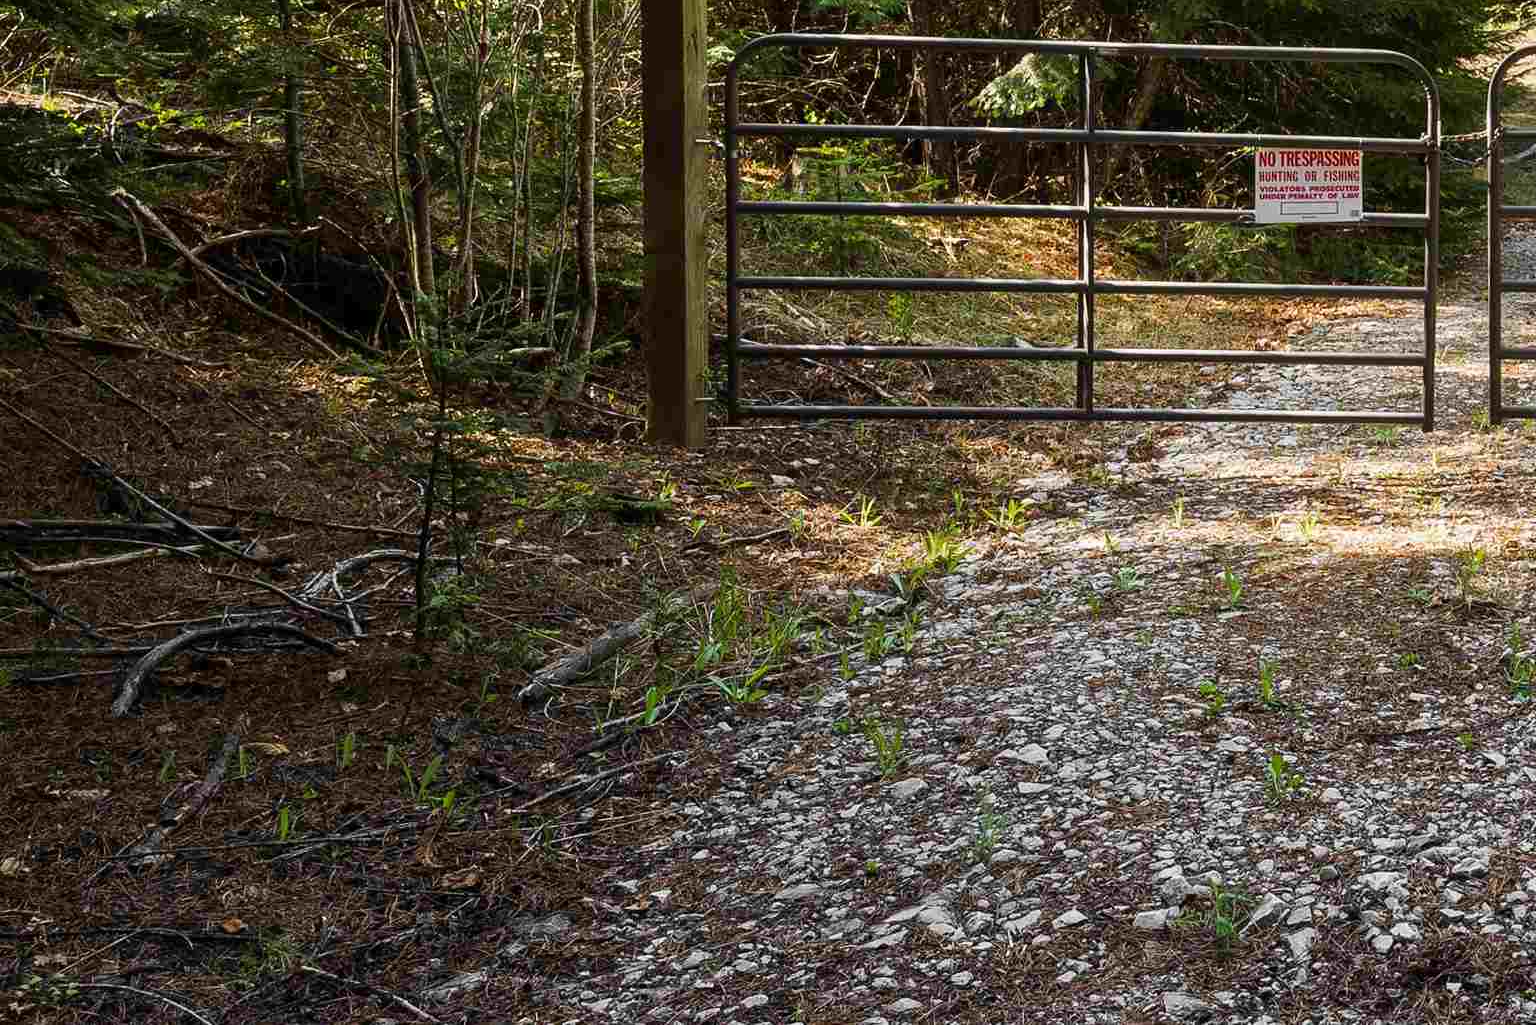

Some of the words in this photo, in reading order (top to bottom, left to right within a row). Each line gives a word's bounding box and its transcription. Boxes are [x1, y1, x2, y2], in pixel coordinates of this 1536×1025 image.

[1259, 151, 1276, 167] NO
[1280, 151, 1359, 167] TRESPASSING
[1259, 171, 1298, 182] HUNTING
[1304, 171, 1317, 182] OR
[1324, 171, 1359, 182] FISHING
